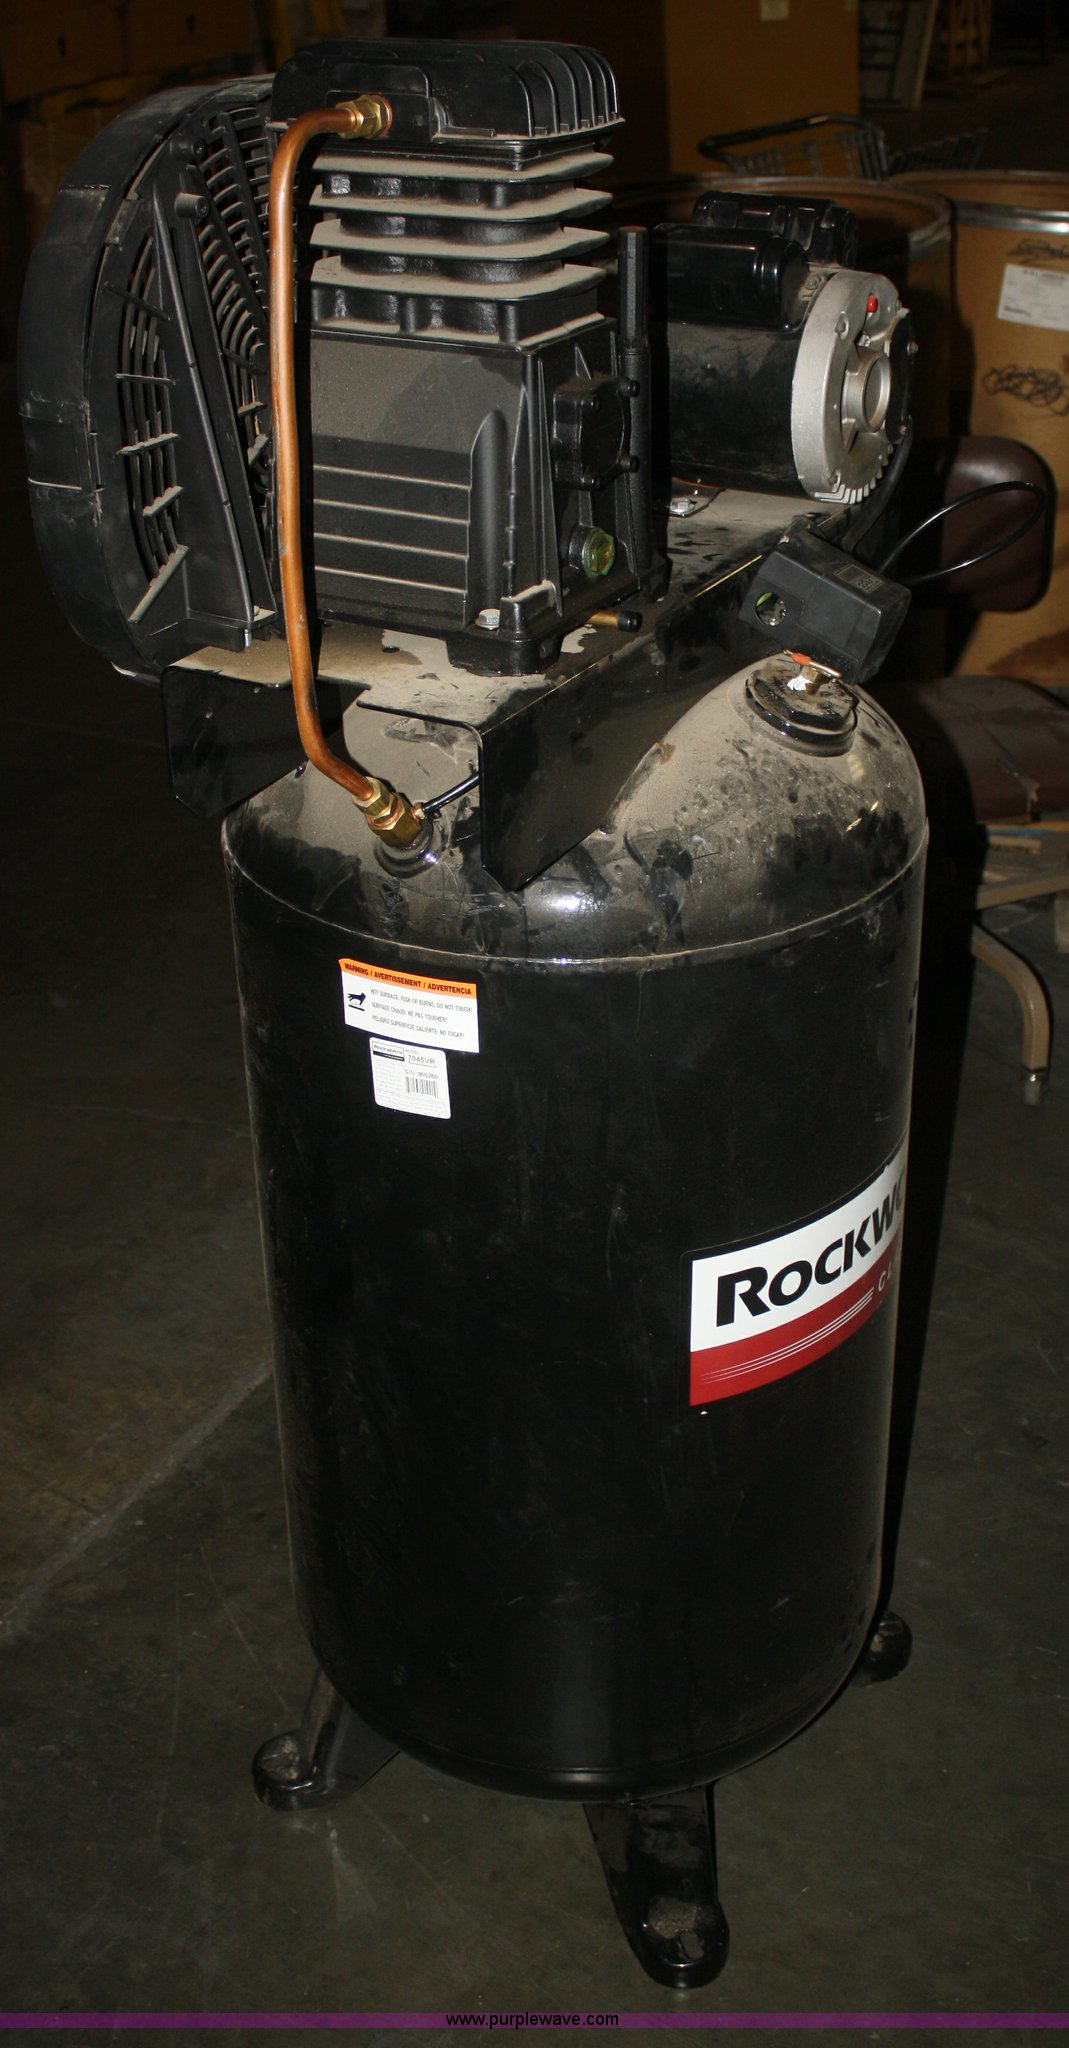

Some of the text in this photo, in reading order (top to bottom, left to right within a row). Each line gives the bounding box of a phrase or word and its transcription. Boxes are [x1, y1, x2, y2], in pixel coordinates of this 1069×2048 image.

[344, 963, 369, 976] WARNING
[374, 972, 421, 989] AVERTISSEMENT
[427, 983, 472, 995] ADVERTENCIA
[445, 1004, 454, 1012] NOT
[407, 1055, 436, 1065] 7045VR
